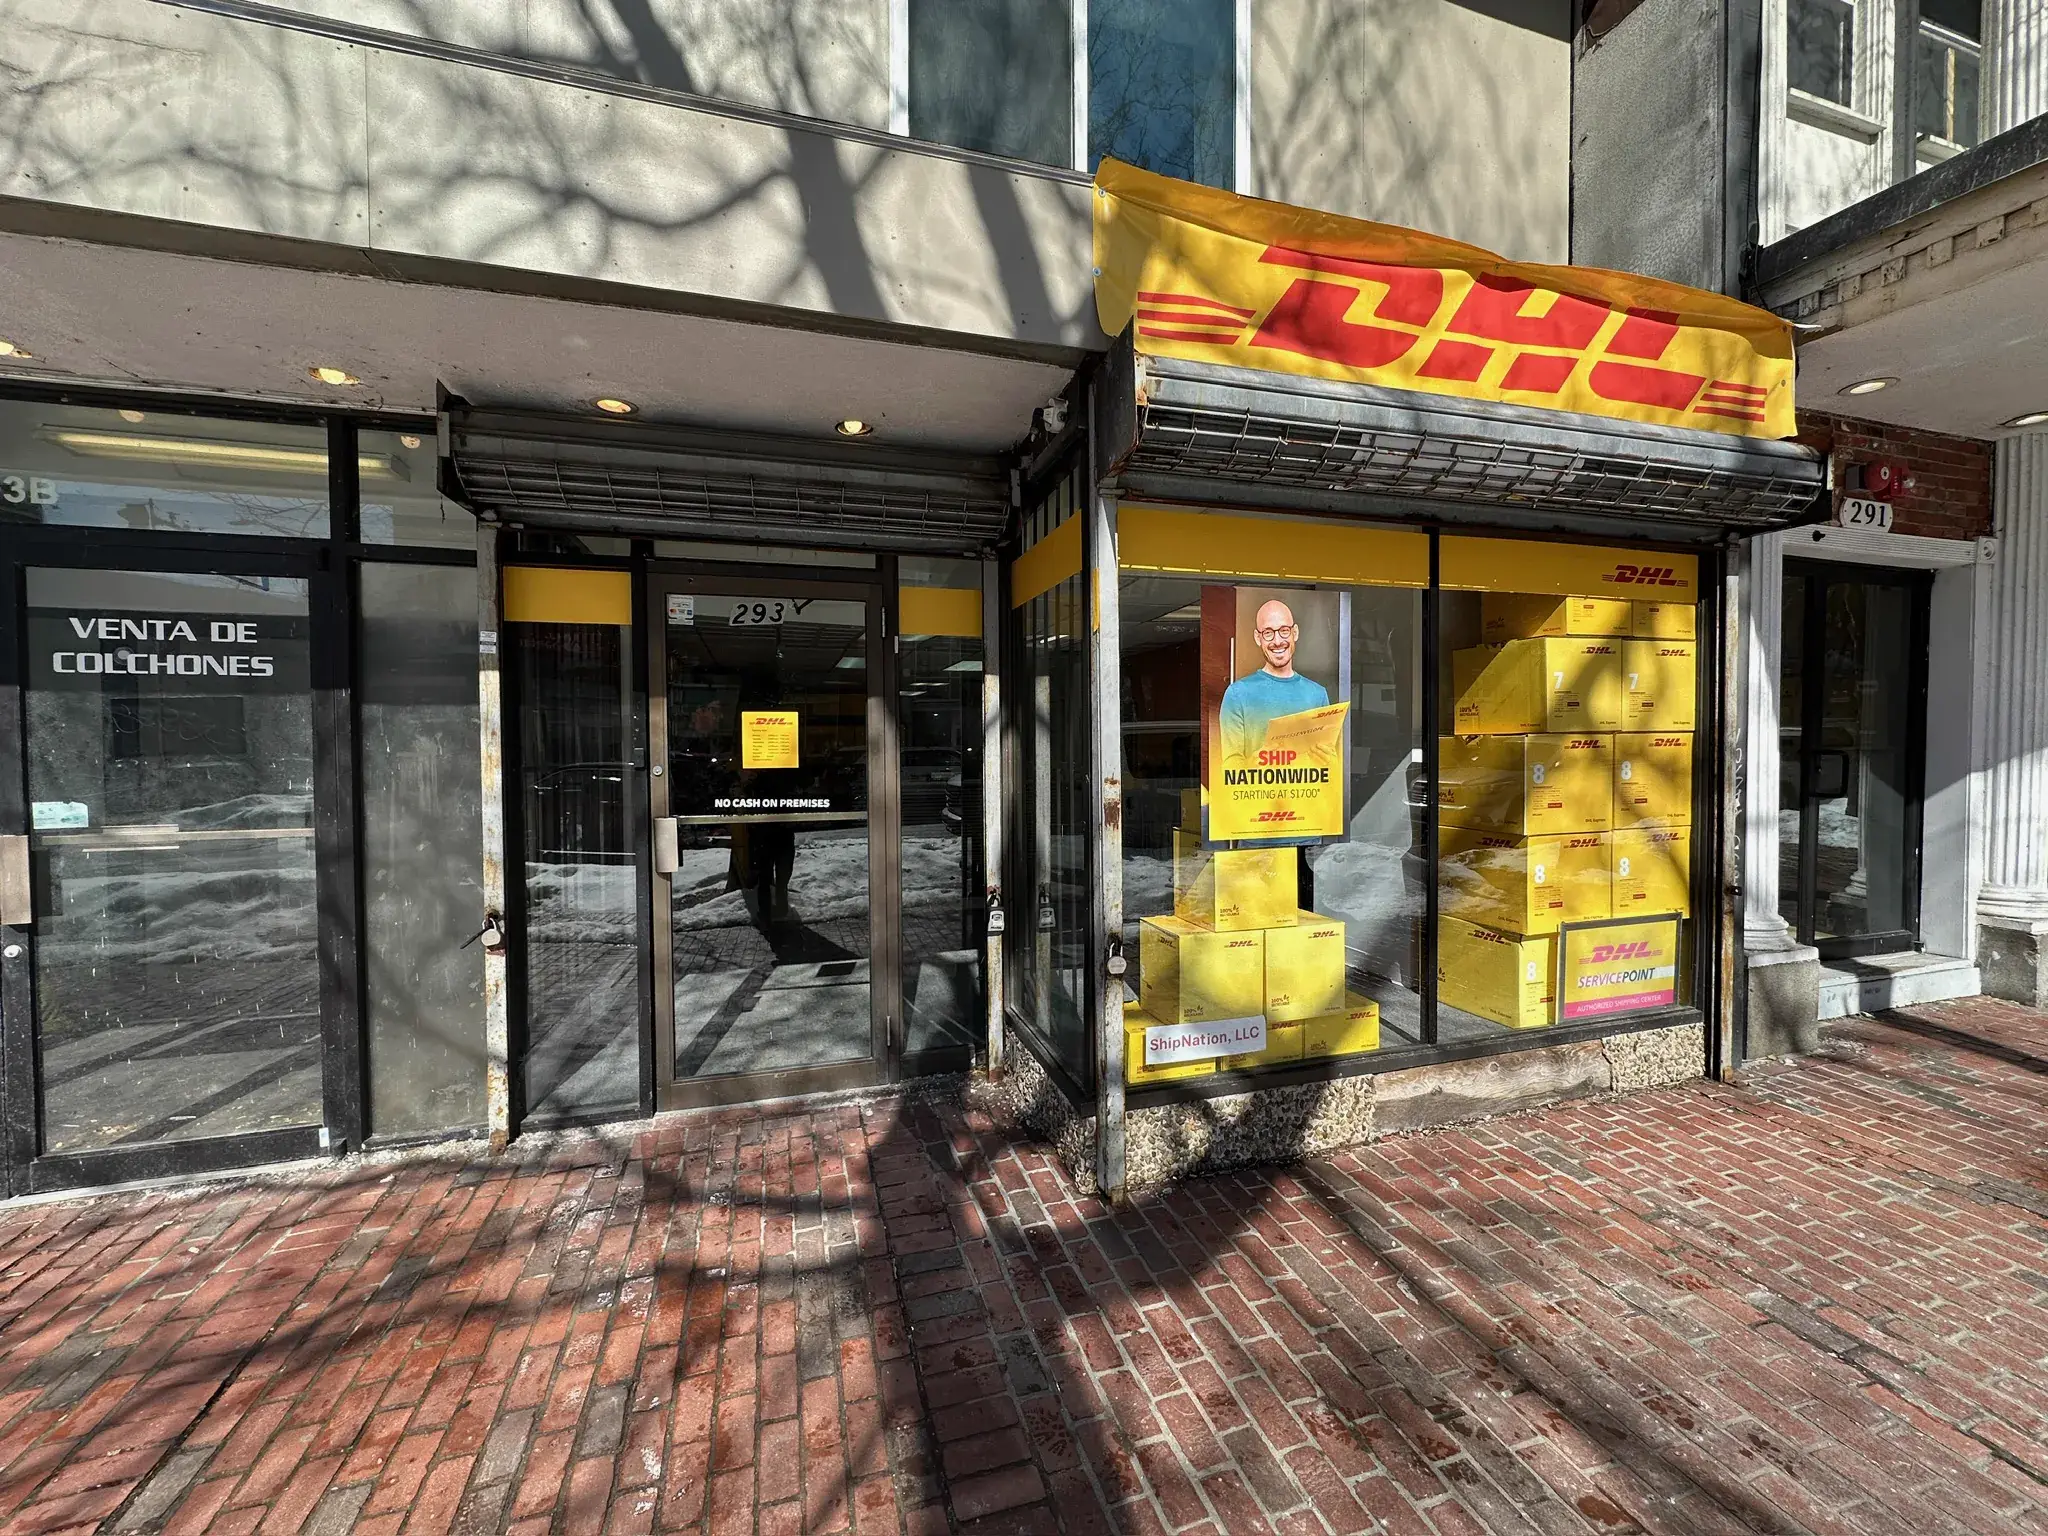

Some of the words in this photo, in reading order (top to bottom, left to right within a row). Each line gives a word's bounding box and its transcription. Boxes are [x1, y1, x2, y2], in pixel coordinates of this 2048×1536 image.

[1249, 244, 1707, 411] DHL
[3, 475, 58, 504] 3B
[1850, 501, 1886, 528] 291
[1612, 564, 1678, 587] DHL
[732, 602, 785, 624] 293
[68, 617, 198, 642] VENTA
[210, 621, 258, 644] DE
[1586, 646, 1611, 654] DHL
[52, 651, 274, 677] COLCHONES
[1553, 671, 1564, 690] 7
[1628, 673, 1639, 690] 7
[755, 717, 787, 725] DHL
[1570, 740, 1600, 749] DHL
[1654, 738, 1682, 747] DHL
[1258, 750, 1297, 766] SHIP
[1224, 767, 1329, 785] NATIONWIDE
[1532, 764, 1545, 784] 8
[1621, 760, 1632, 780] 8
[714, 798, 731, 808] NO
[732, 798, 761, 808] CASH
[762, 798, 778, 808] ON
[779, 798, 831, 808] PREMISES
[1233, 789, 1276, 800] STARTING
[1277, 789, 1288, 799] AT
[1258, 811, 1297, 822] DHL
[1481, 837, 1515, 848] DHL
[1569, 838, 1599, 848] DHL
[1651, 832, 1679, 842] DHL
[1534, 864, 1546, 884] 8
[1619, 857, 1630, 877] 8
[1160, 936, 1173, 948] DHL
[1312, 930, 1336, 938] DHL
[1473, 929, 1506, 944] DHL
[1229, 939, 1254, 948] DHL
[1590, 941, 1652, 964] DHL
[1526, 961, 1537, 981] 8
[1578, 968, 1655, 988] SERVICEPOINT
[1577, 1002, 1613, 1012] AUTHORIZED
[1615, 998, 1640, 1008] SHIPPING
[1641, 995, 1662, 1003] CENTER
[1350, 1011, 1371, 1020] DHL
[1271, 1021, 1295, 1030] DHL
[1150, 1033, 1231, 1051] ShipNation,
[1235, 1026, 1260, 1041] LLC
